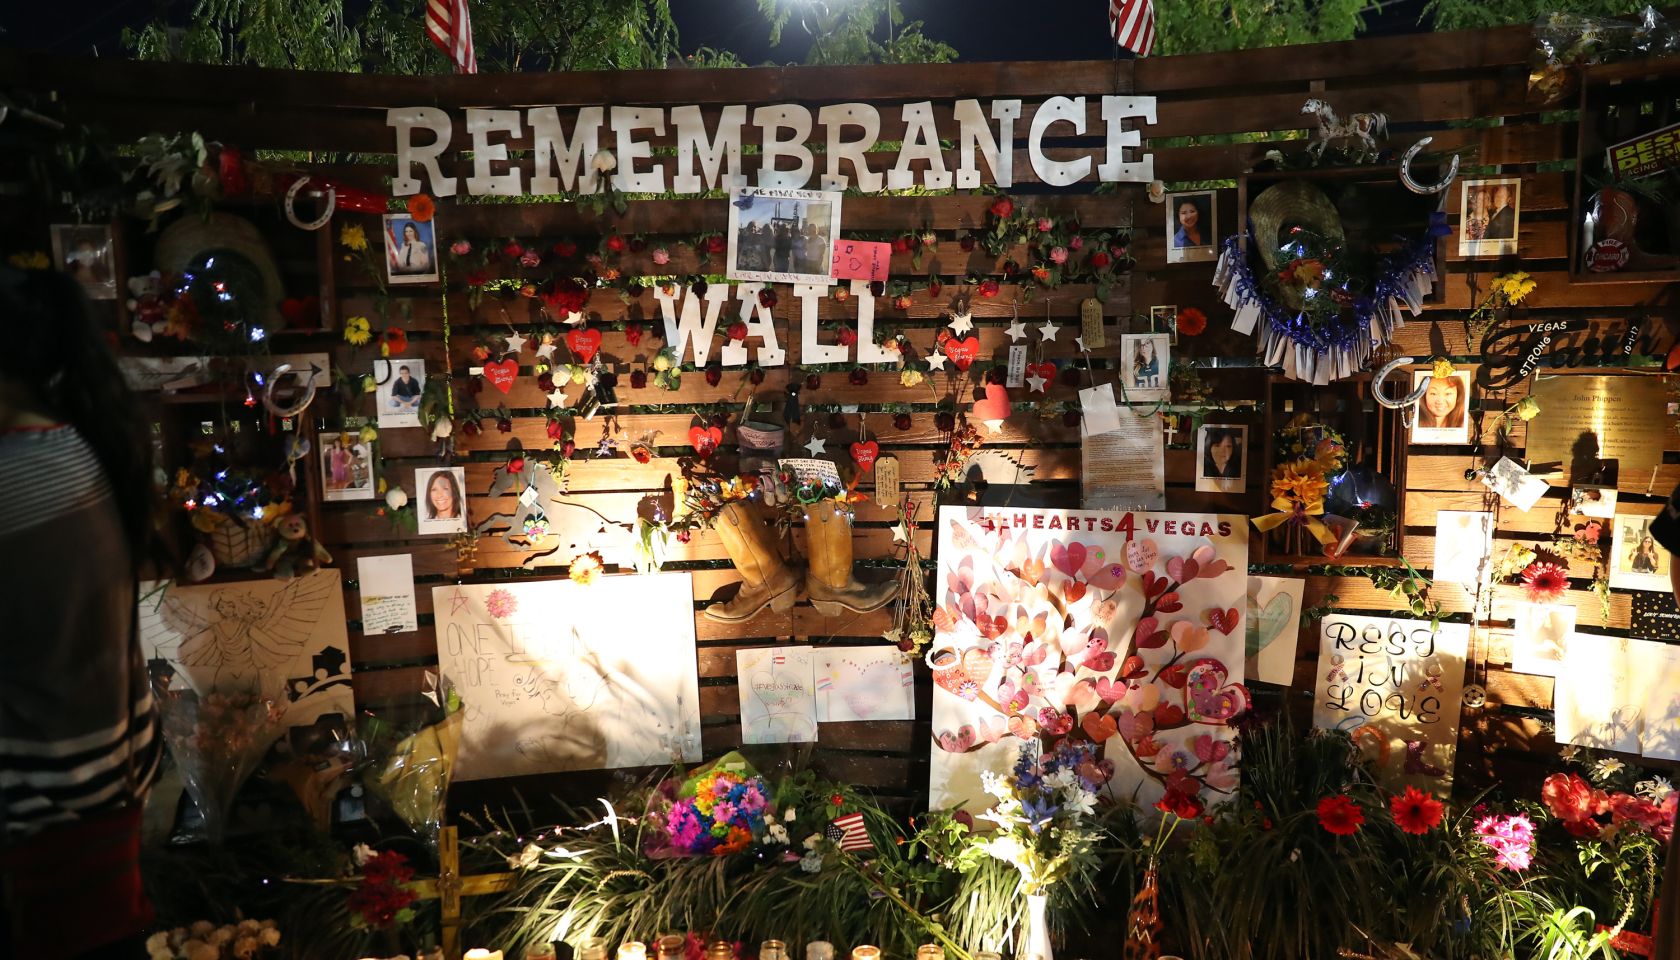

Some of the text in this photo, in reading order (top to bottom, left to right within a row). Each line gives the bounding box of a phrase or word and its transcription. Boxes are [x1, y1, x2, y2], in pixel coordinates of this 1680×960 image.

[385, 95, 1158, 198] REMEMBRANCE
[653, 282, 900, 367] WALL
[1528, 321, 1567, 333] VEGAS
[1624, 325, 1640, 355] 10-1-17
[1520, 336, 1551, 378] STRONG
[1573, 394, 1590, 402] John
[447, 622, 495, 656] ONE
[1326, 622, 1443, 657] REST
[454, 656, 500, 688] HOPE
[1325, 685, 1440, 723] LOVE
